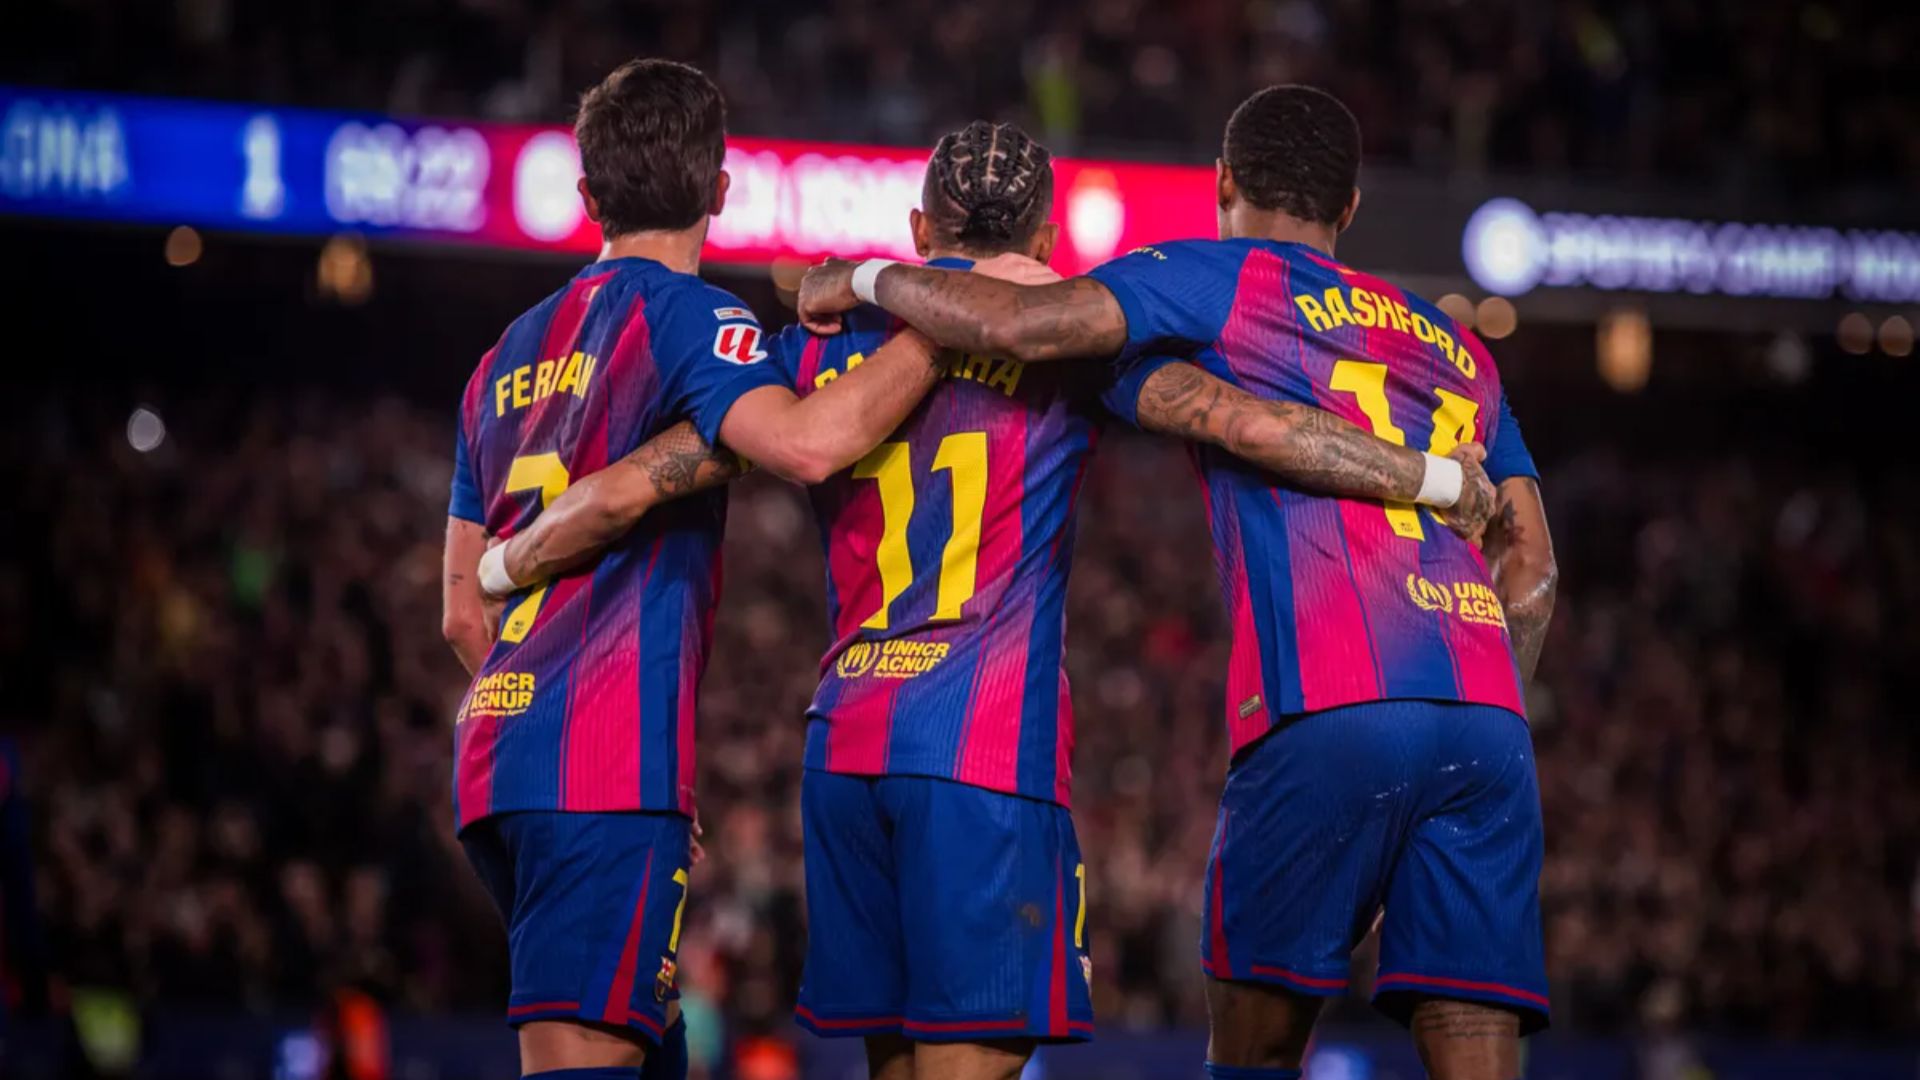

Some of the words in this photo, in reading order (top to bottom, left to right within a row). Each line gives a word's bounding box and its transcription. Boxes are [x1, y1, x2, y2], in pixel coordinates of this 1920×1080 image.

[1294, 286, 1477, 380] RASHFORD
[500, 451, 569, 643] 7
[851, 431, 988, 630] 11
[1453, 582, 1500, 603] UNH
[882, 639, 951, 658] UNHCR
[469, 690, 534, 709] ACNUR
